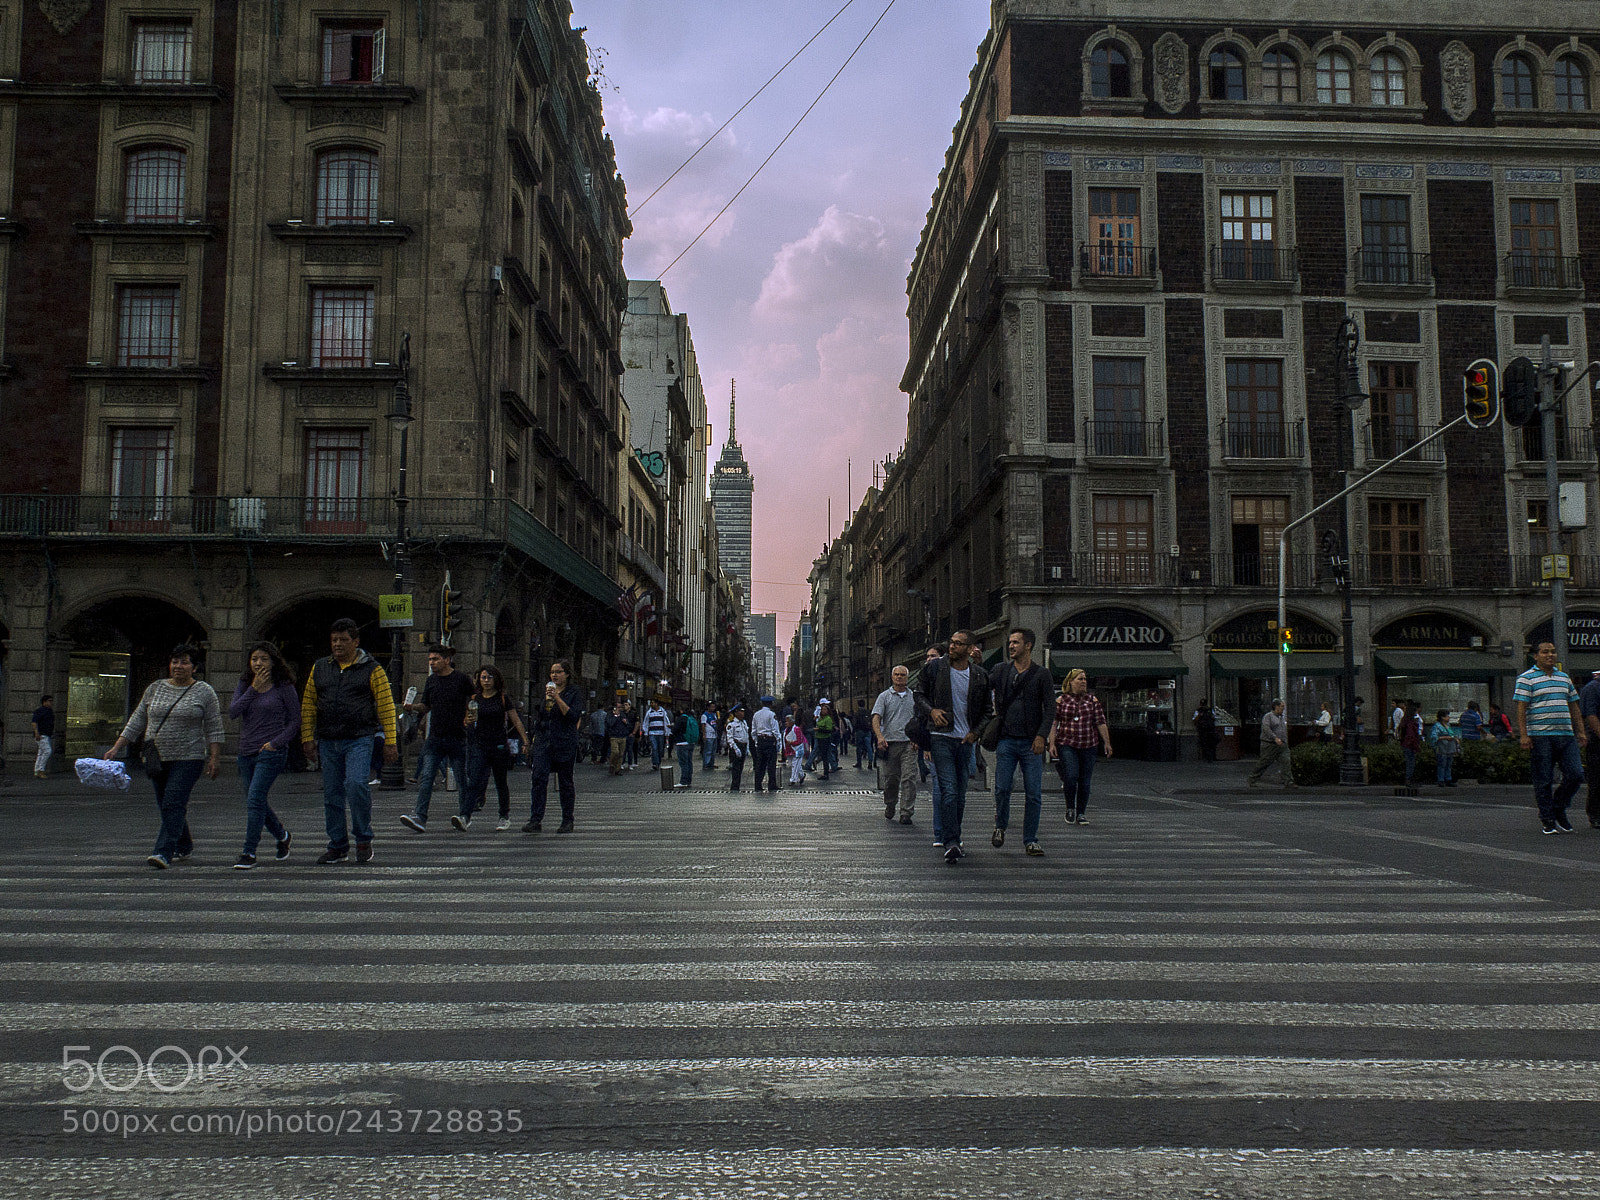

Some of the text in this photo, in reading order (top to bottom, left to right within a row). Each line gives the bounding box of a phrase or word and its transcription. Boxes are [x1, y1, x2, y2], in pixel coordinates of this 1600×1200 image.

[1062, 626, 1165, 643] BIZZARRO
[1210, 632, 1264, 644] REGALOS
[1400, 626, 1459, 639] ARMANI
[1567, 632, 1600, 646] URA
